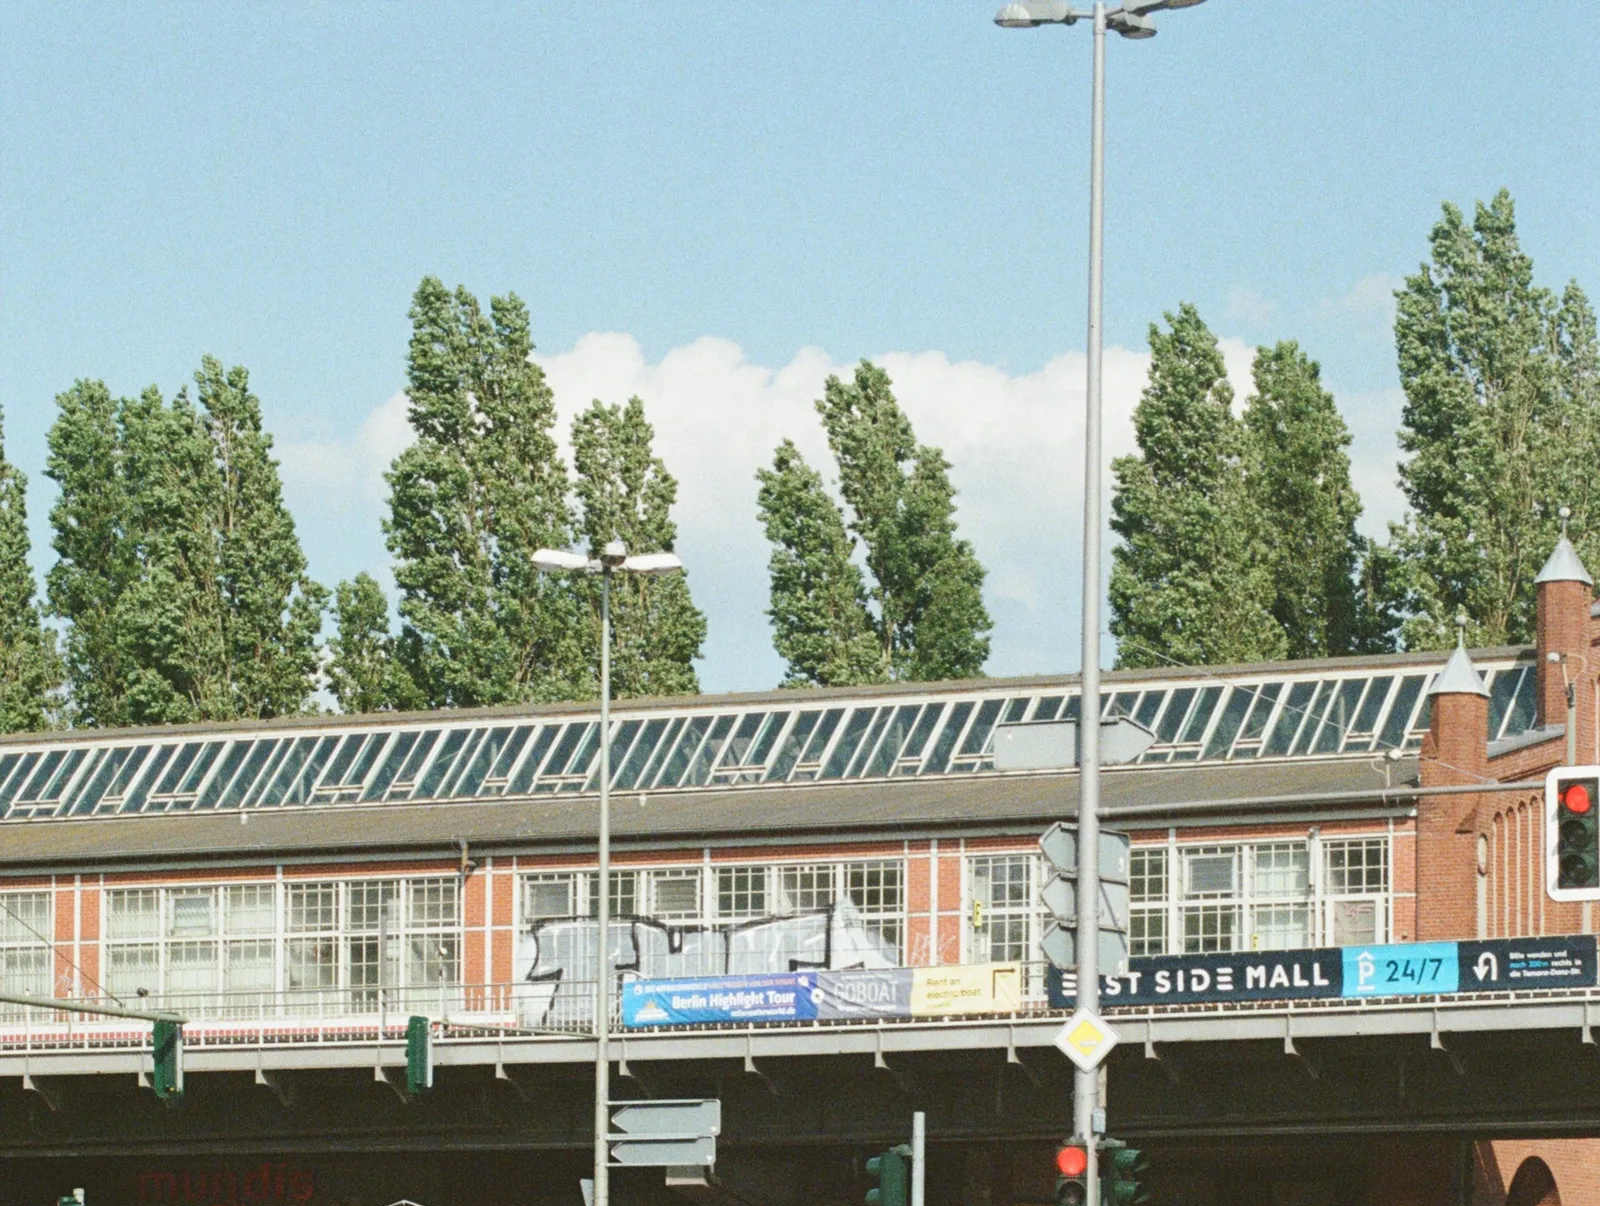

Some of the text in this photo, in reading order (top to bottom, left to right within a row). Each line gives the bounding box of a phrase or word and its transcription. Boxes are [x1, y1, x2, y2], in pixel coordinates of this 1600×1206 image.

[1553, 950, 1567, 958] und
[926, 978, 947, 987] Rent
[1061, 963, 1329, 997] EST SIDE MALL
[1386, 958, 1443, 986] 24/7
[672, 990, 796, 1011] Berlin Highlight Tour
[833, 980, 899, 1002] GOBOAT
[926, 988, 981, 1000] electric boat
